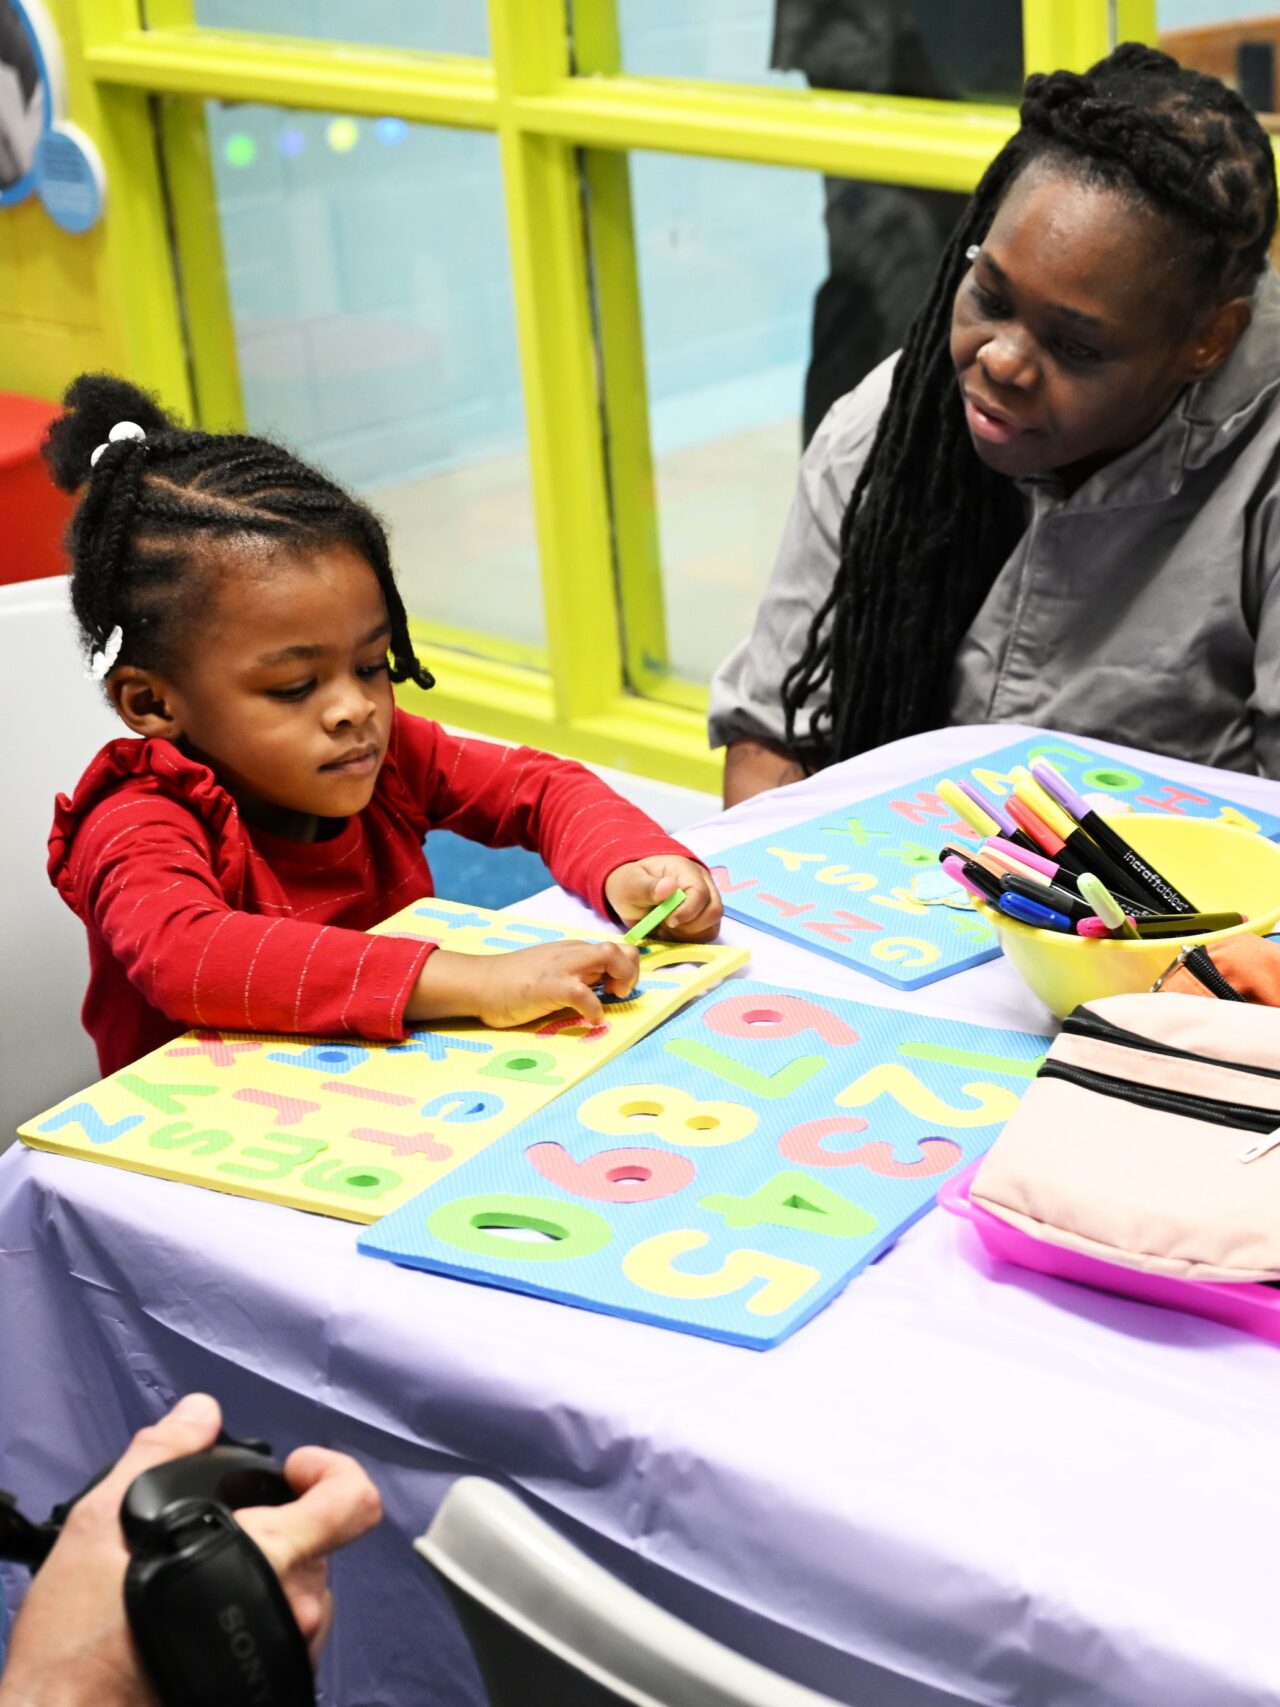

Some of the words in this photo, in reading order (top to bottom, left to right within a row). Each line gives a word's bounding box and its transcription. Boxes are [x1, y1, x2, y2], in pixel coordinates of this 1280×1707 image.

[1136, 786, 1211, 815] H
[766, 846, 827, 872] Y
[819, 817, 892, 846] X
[815, 864, 879, 892] S
[1122, 850, 1185, 912] incraftables
[870, 936, 940, 967] G
[664, 1038, 828, 1099] 7
[834, 1063, 1021, 1128] 2
[420, 1091, 505, 1123] e
[577, 1083, 759, 1147] 8
[777, 1115, 963, 1179] 3
[699, 1170, 878, 1238] 4
[622, 1229, 821, 1316] 5
